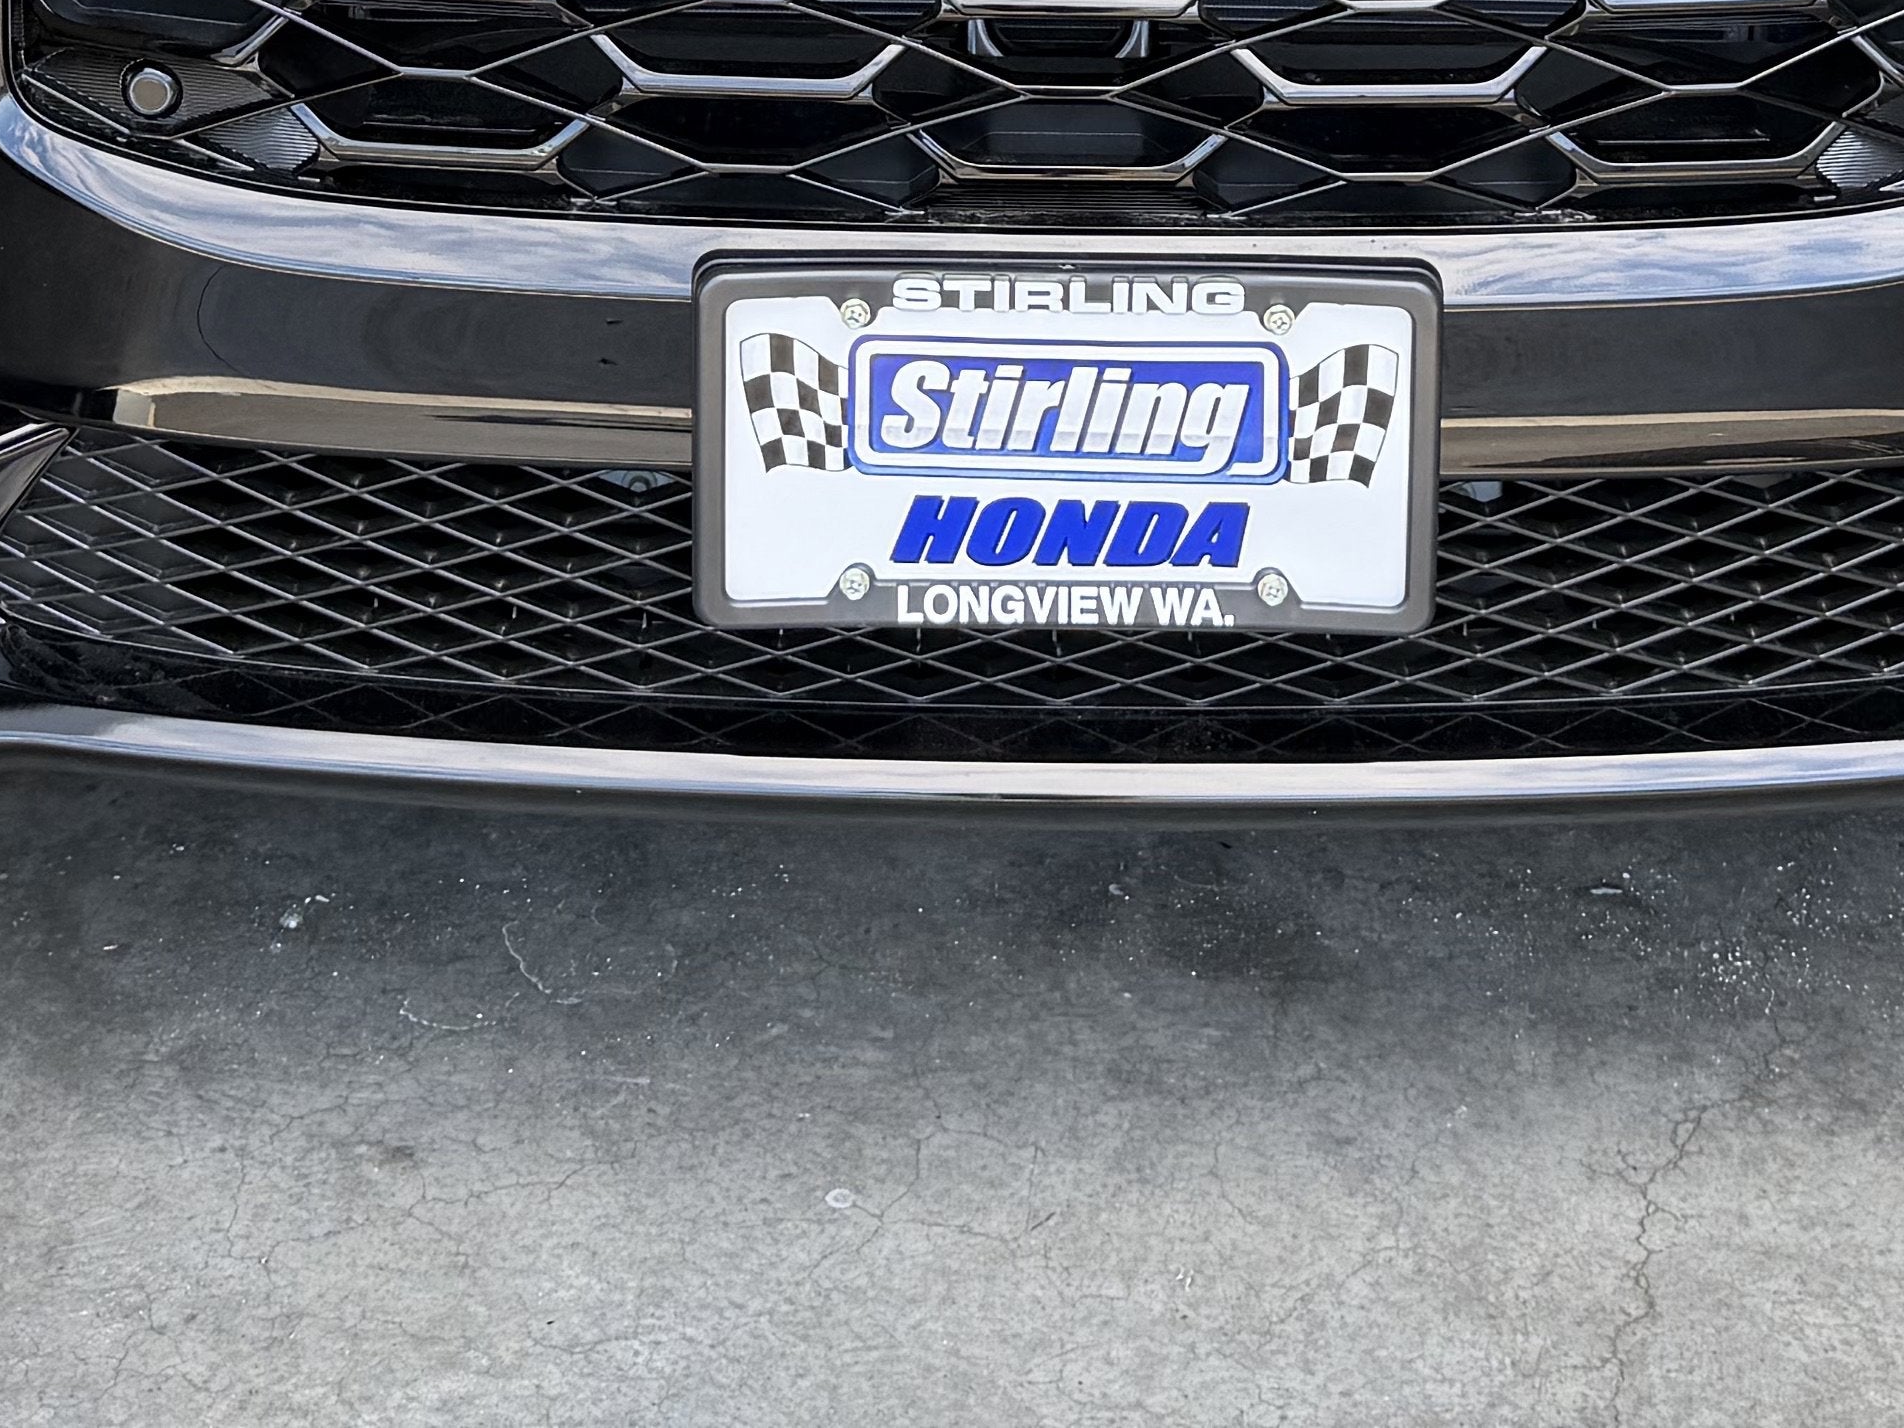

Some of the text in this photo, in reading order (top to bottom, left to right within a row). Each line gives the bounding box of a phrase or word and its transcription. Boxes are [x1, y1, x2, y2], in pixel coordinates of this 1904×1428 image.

[892, 278, 1246, 313] STIRLING
[881, 359, 1250, 475] Stirling
[890, 495, 1250, 567] HONDA
[897, 584, 1234, 626] LONGVIEW WA.
